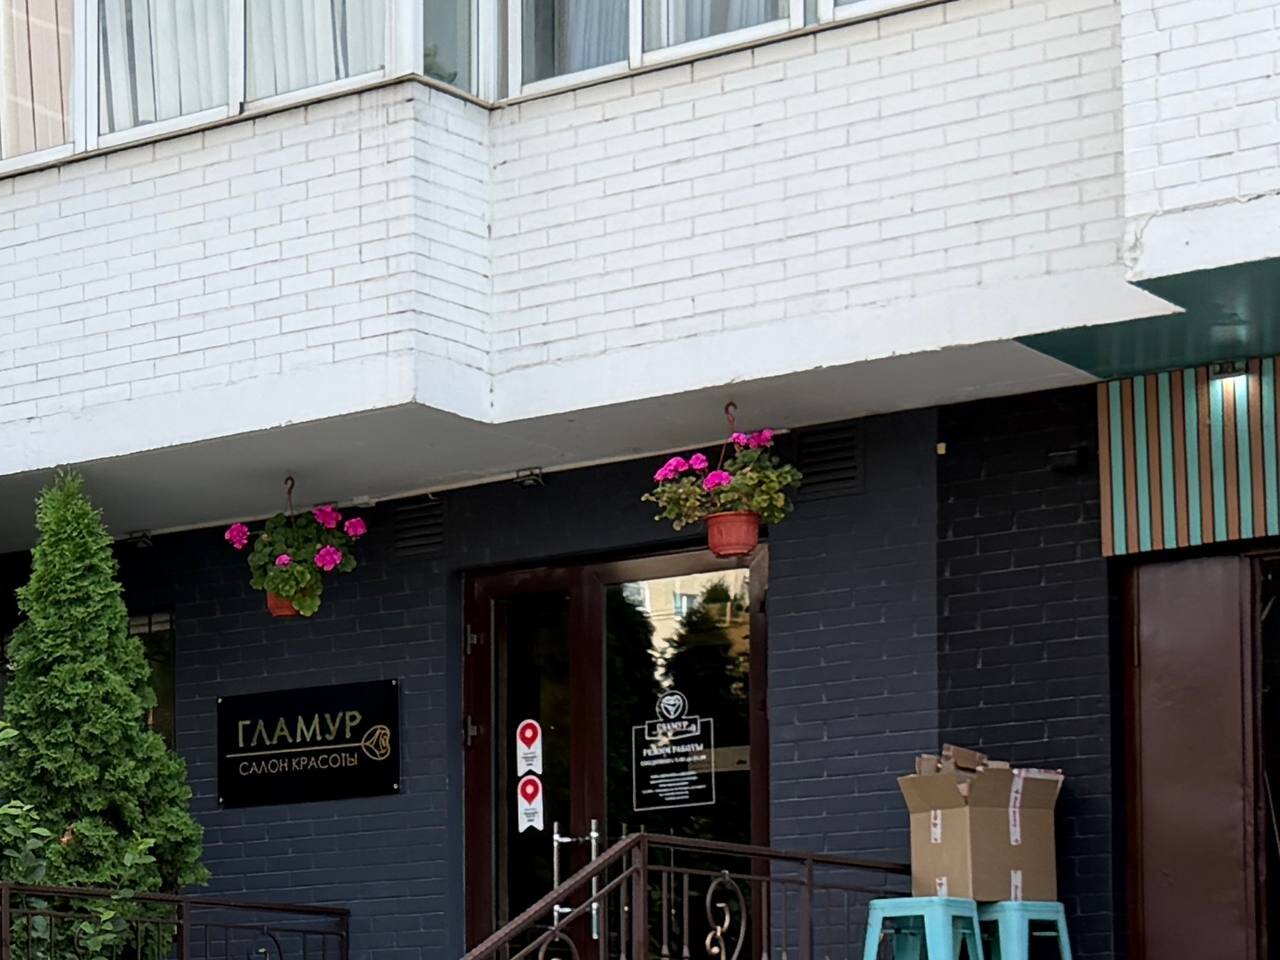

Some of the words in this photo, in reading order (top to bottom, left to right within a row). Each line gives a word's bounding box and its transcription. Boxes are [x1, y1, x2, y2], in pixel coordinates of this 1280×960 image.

[237, 710, 362, 748] ГЛАМУР
[238, 758, 289, 776] САЛОН
[291, 752, 358, 771] КРАСОТЫ
